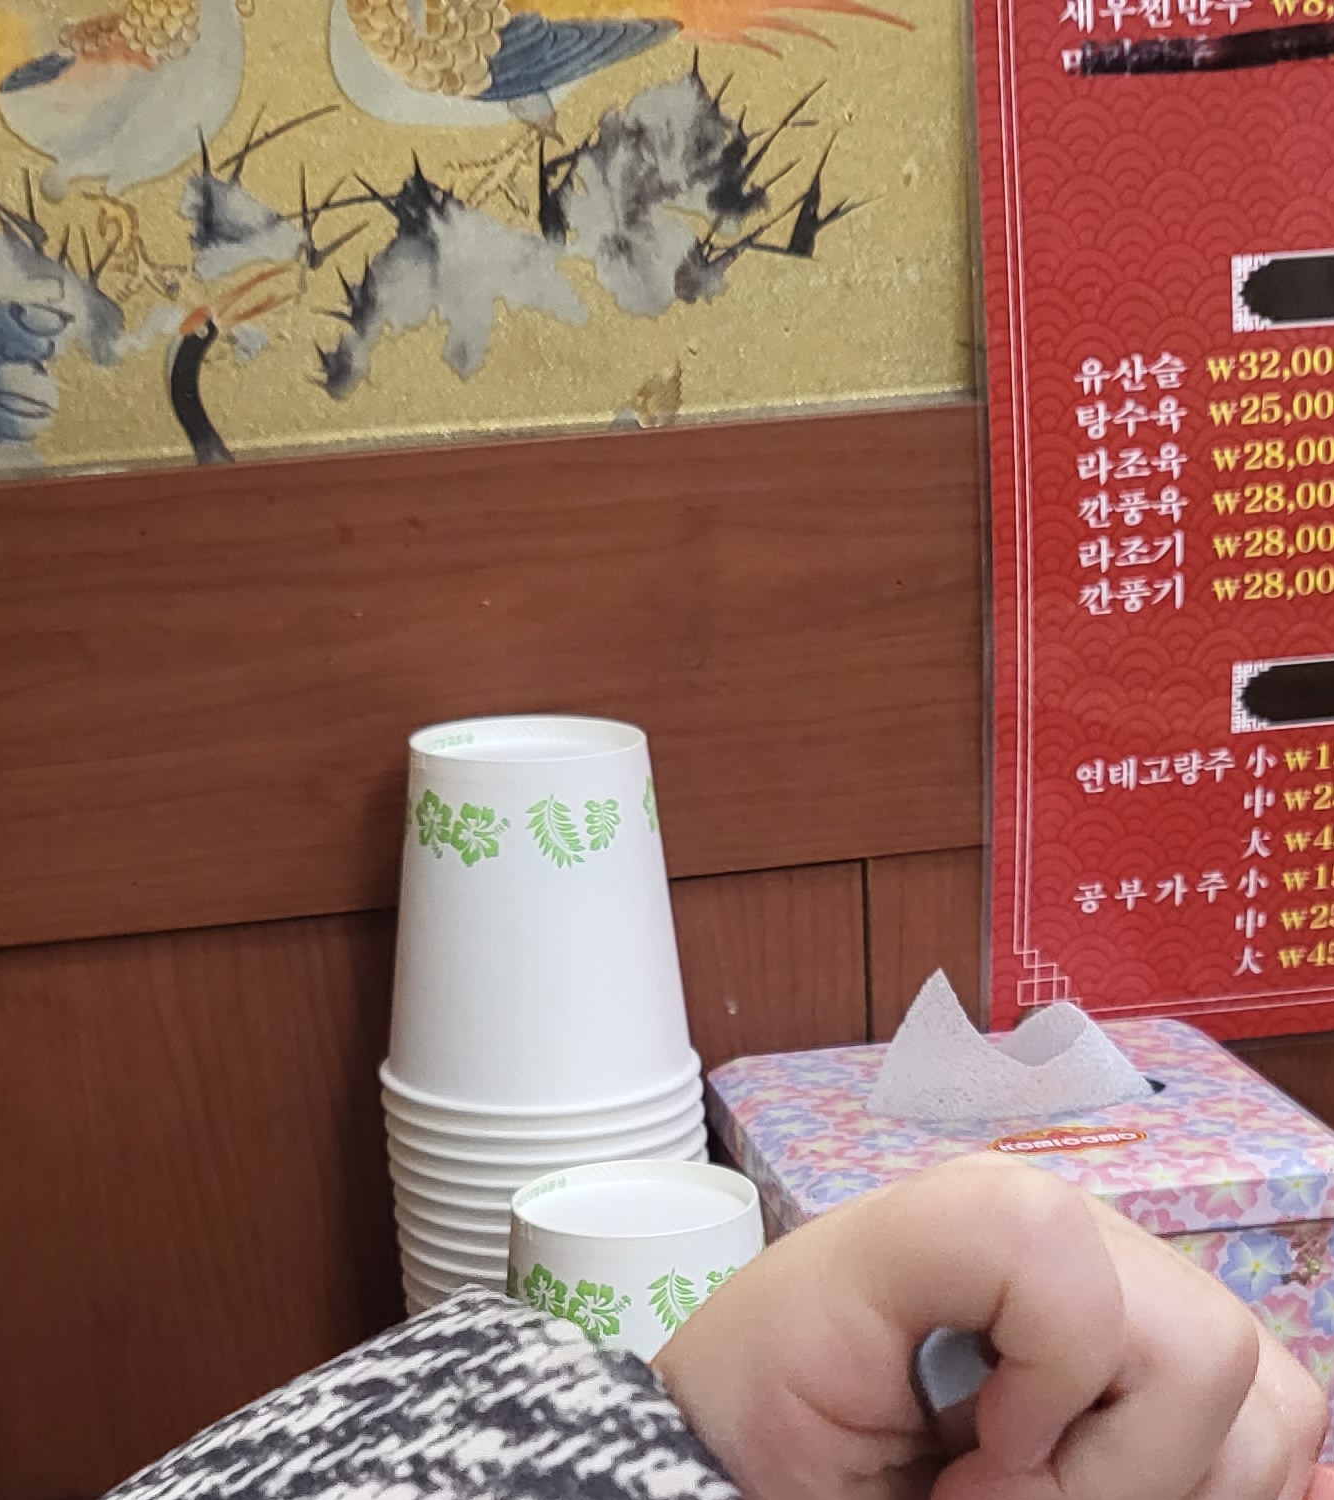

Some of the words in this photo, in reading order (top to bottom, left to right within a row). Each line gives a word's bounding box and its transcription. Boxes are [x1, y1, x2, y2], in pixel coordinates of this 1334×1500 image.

[1074, 351, 1188, 396] 유산슬
[1075, 396, 1187, 440] 탕수육
[1076, 442, 1188, 485] 라조육
[1077, 485, 1189, 529] 깐풍육
[1077, 529, 1185, 573] 라조기
[1078, 571, 1185, 615] 깐풍기
[1076, 746, 1236, 794] 연태고량주
[1246, 744, 1277, 778] 小
[1243, 785, 1276, 818] 中
[1241, 826, 1272, 859] 大
[1237, 866, 1270, 899] 小
[1234, 906, 1267, 939] 中
[1233, 944, 1265, 976] 大
